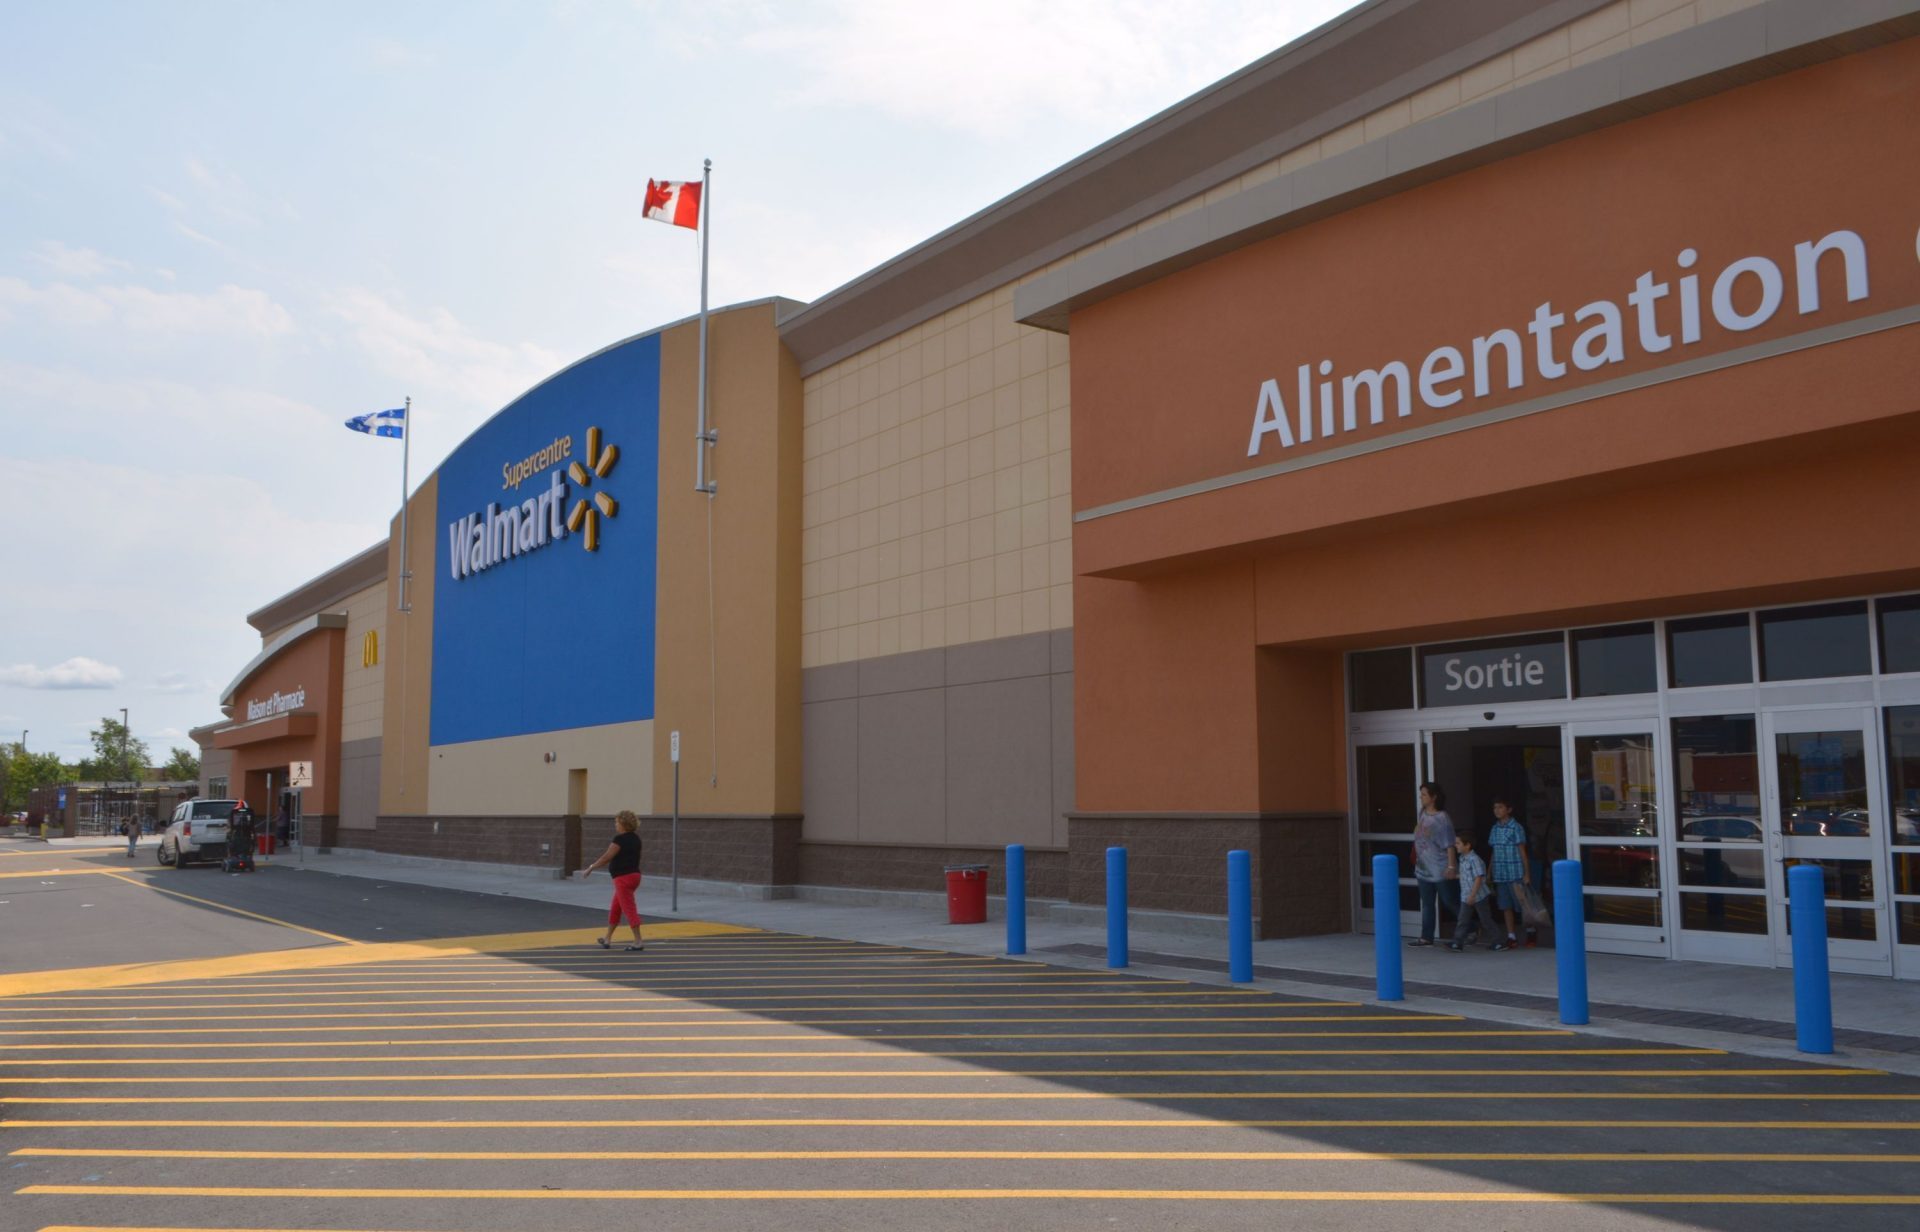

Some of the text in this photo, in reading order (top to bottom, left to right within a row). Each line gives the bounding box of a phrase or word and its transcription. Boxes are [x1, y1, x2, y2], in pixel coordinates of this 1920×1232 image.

[1246, 229, 1870, 457] Alimentation
[502, 434, 572, 490] Supercentre
[449, 469, 567, 580] Walmart
[1445, 652, 1544, 691] Sortie
[266, 697, 273, 716] et
